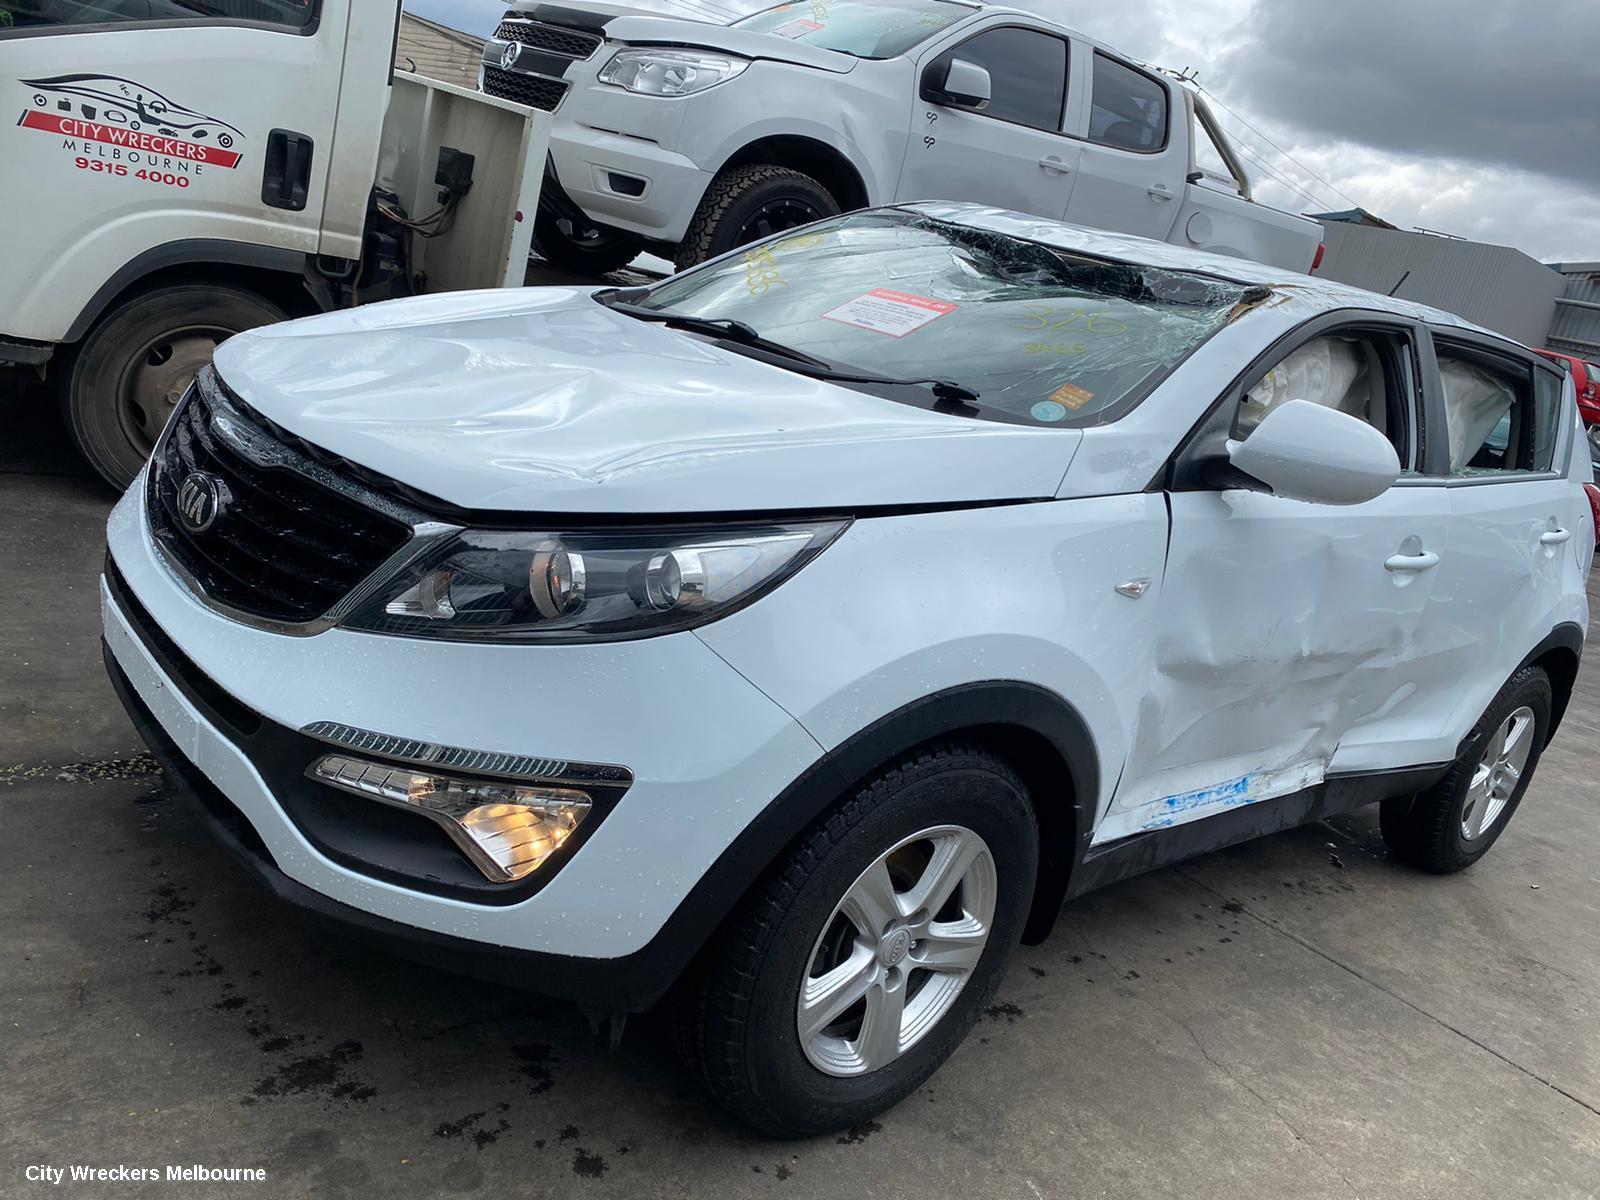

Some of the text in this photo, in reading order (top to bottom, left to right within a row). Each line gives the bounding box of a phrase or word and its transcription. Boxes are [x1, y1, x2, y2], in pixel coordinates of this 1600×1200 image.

[59, 118, 207, 160] CITY WRECKERS
[63, 139, 203, 175] MELBOURNE
[75, 157, 190, 188] 9315 4000
